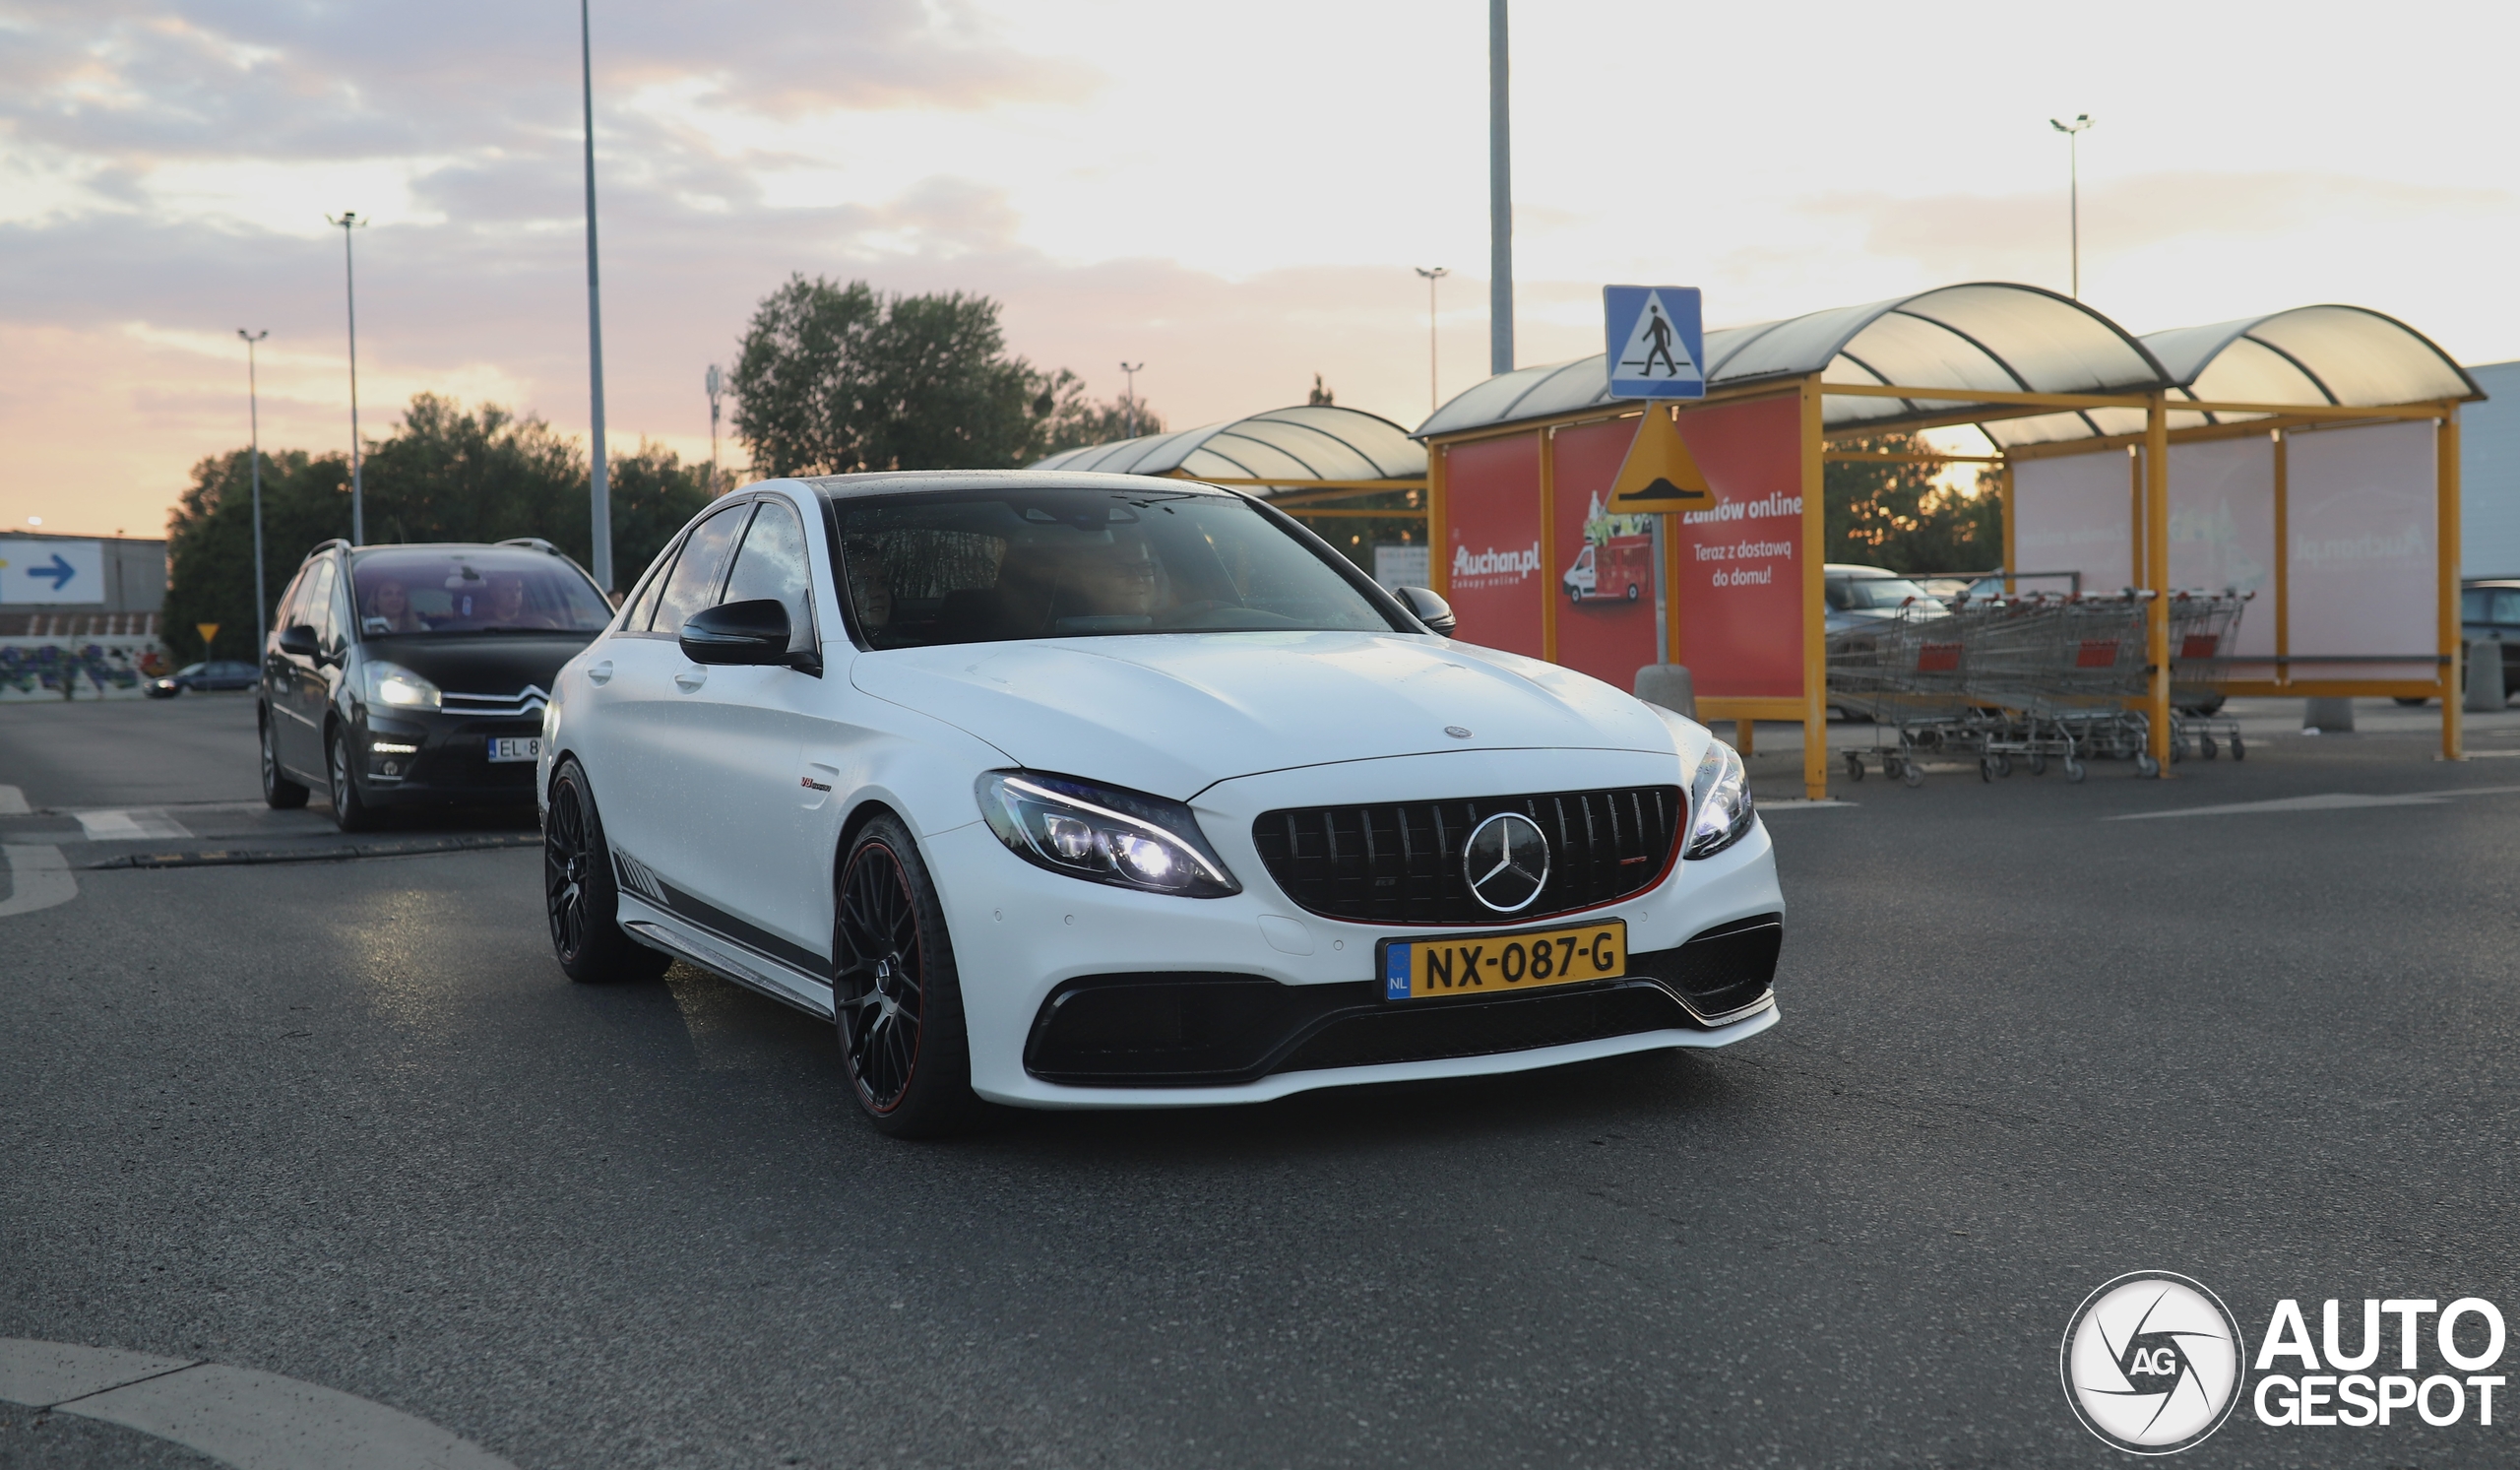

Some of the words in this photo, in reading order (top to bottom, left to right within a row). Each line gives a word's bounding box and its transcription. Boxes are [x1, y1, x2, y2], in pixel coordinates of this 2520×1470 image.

[1748, 490, 1802, 518] online
[1452, 541, 1541, 579] Auchan.pl
[1694, 543, 1725, 561] Teraz
[1728, 544, 1735, 559] z
[1737, 540, 1792, 560] dostawą
[1713, 568, 1729, 587] do
[1731, 564, 1772, 586] domu!
[500, 739, 522, 757] EL
[1427, 932, 1614, 990] NX-087-G
[1390, 978, 1408, 990] NL
